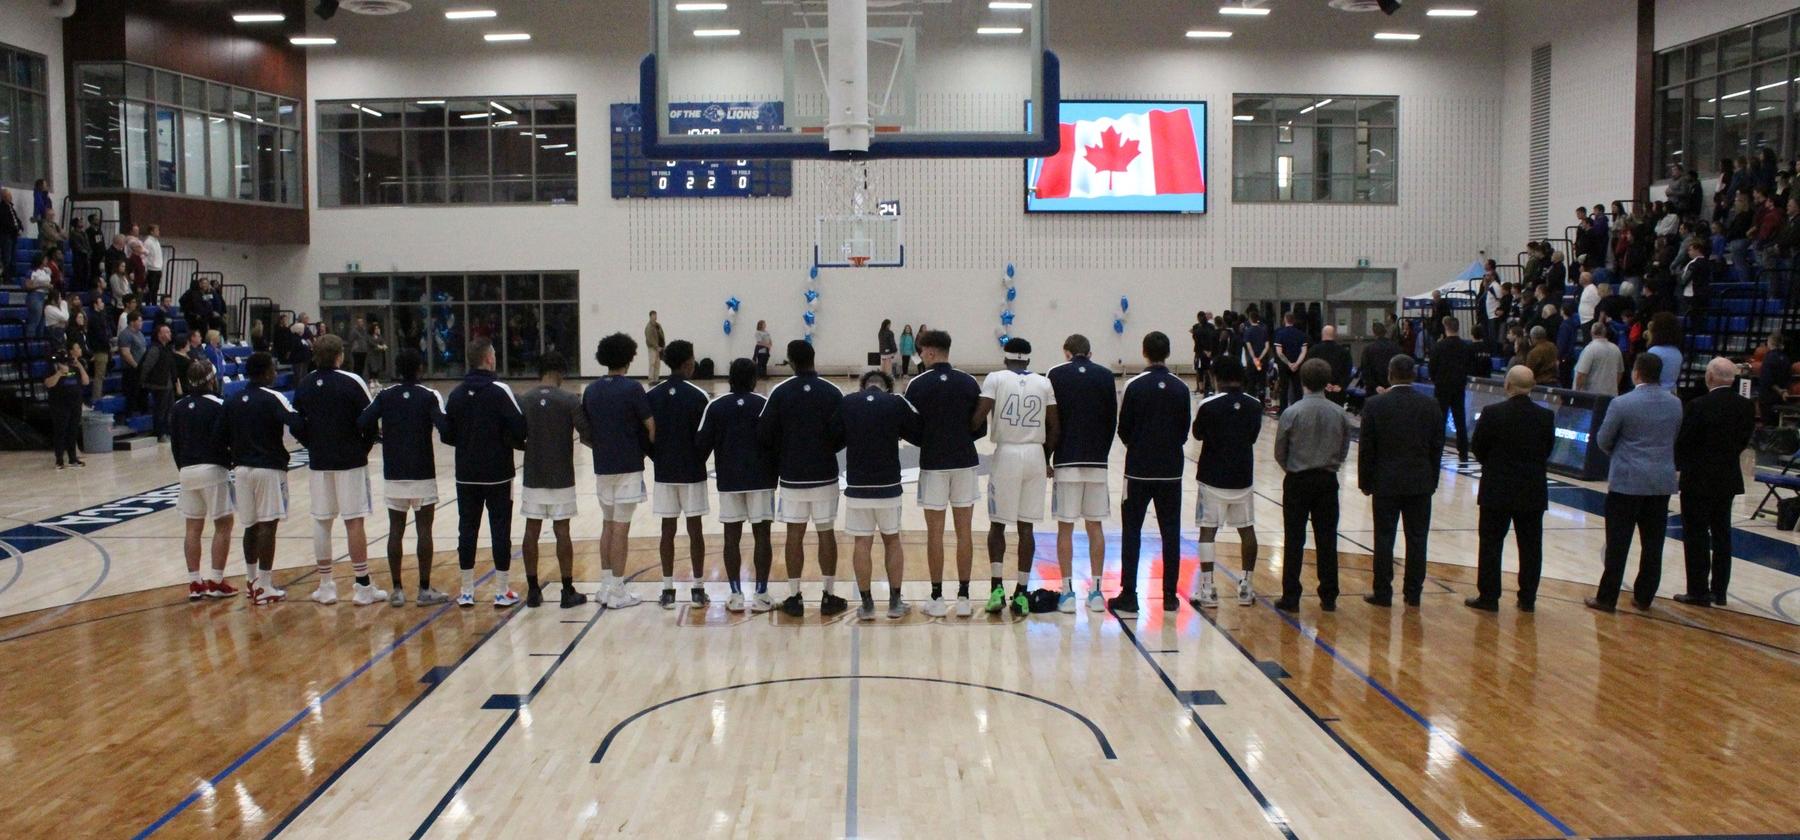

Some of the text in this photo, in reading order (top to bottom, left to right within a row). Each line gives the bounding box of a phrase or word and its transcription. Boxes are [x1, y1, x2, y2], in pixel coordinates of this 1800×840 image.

[669, 110, 702, 119] OF THE
[726, 110, 760, 120] LIONS
[658, 177, 667, 190] 0
[686, 176, 695, 189] 2
[707, 176, 716, 189] 2
[738, 176, 747, 189] 0
[880, 203, 897, 216] 24
[1000, 394, 1042, 427] 42
